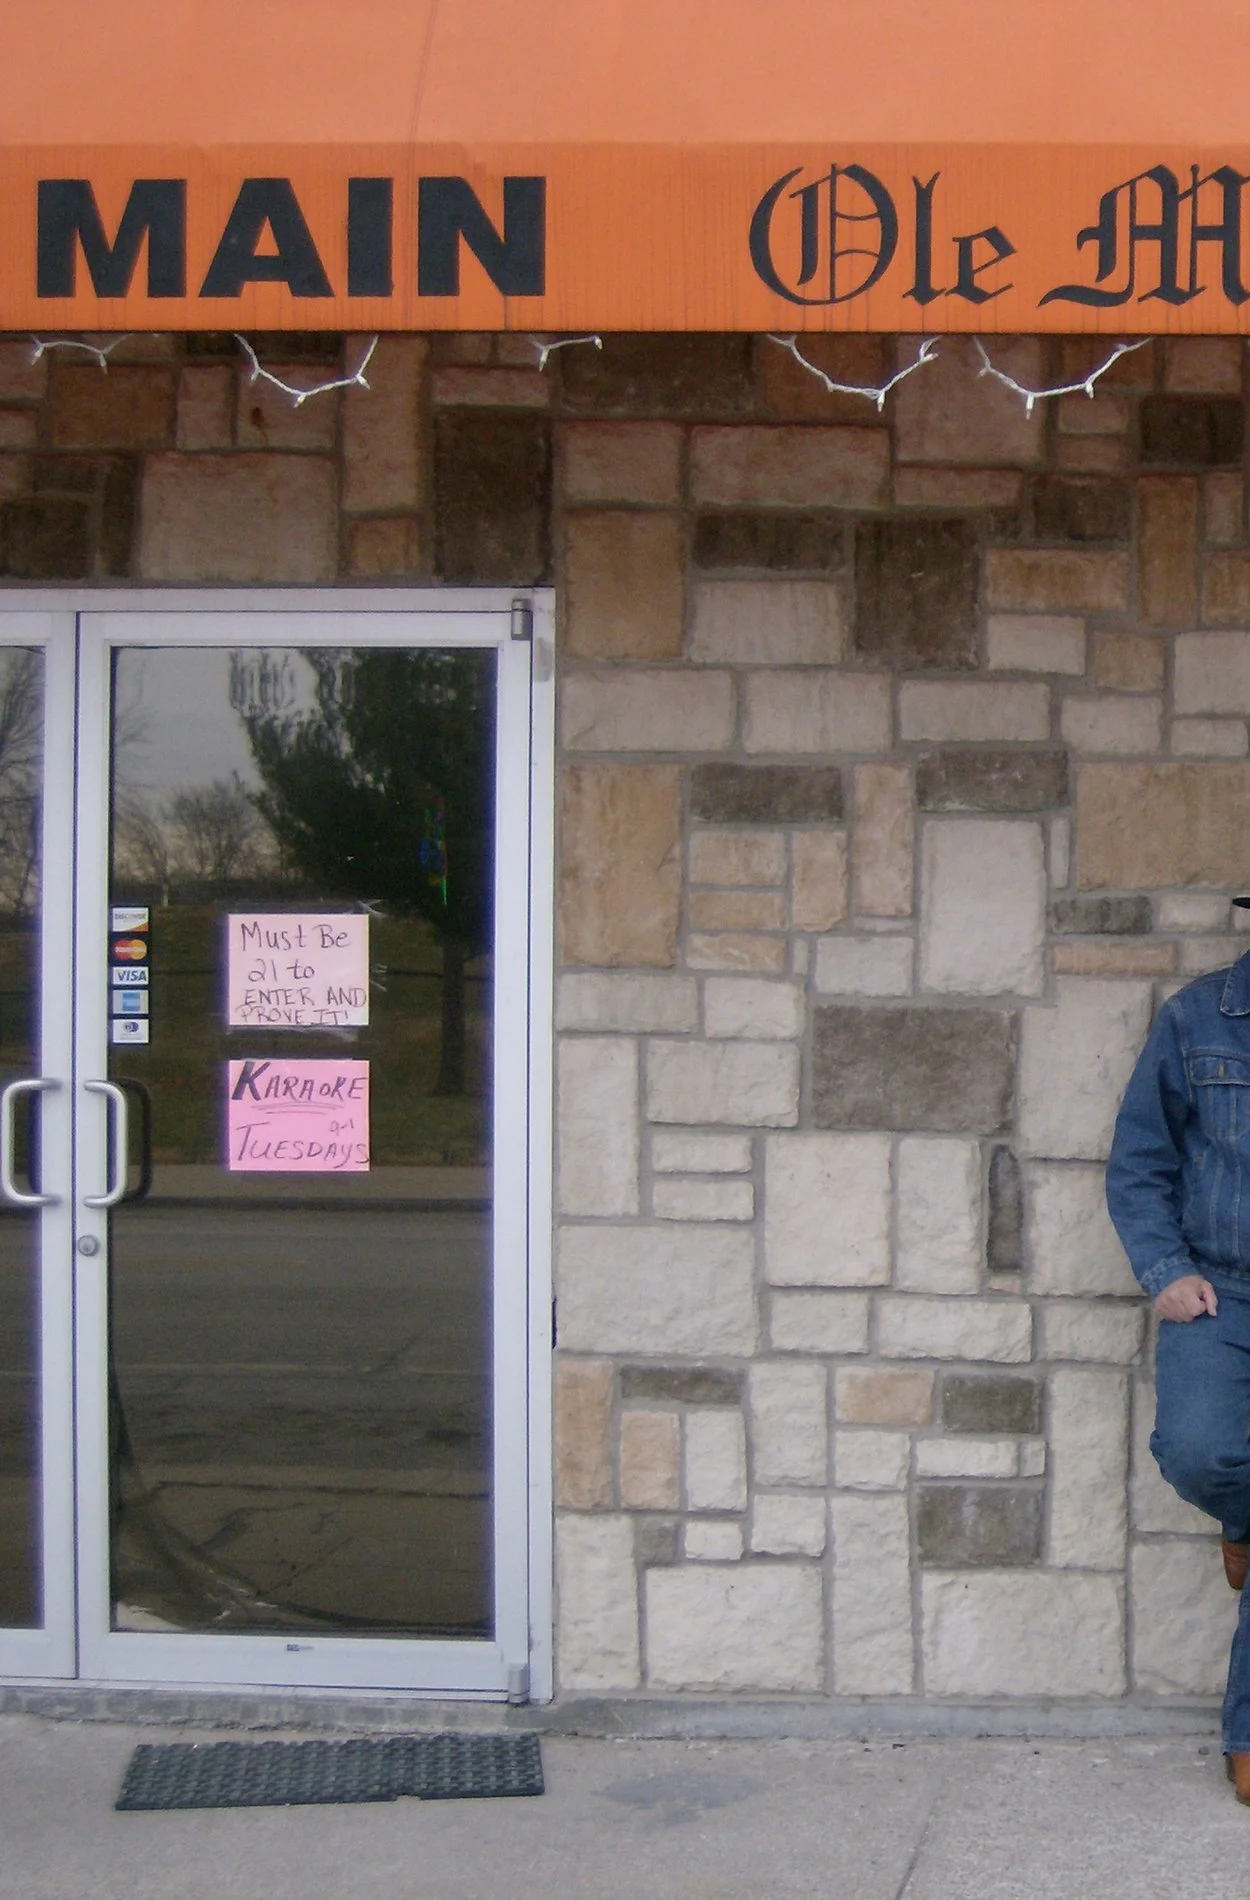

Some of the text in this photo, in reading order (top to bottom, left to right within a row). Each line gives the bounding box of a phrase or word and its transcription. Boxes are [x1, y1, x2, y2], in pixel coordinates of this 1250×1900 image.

[37, 176, 546, 298] MAIN
[749, 163, 1017, 305] Ole
[240, 921, 350, 951] Must Be
[117, 969, 147, 982] VISA
[248, 958, 315, 981] 21 to
[243, 986, 367, 1008] ENTER AND
[234, 1004, 303, 1025] PROVE
[231, 1061, 368, 1102] KARAOKE
